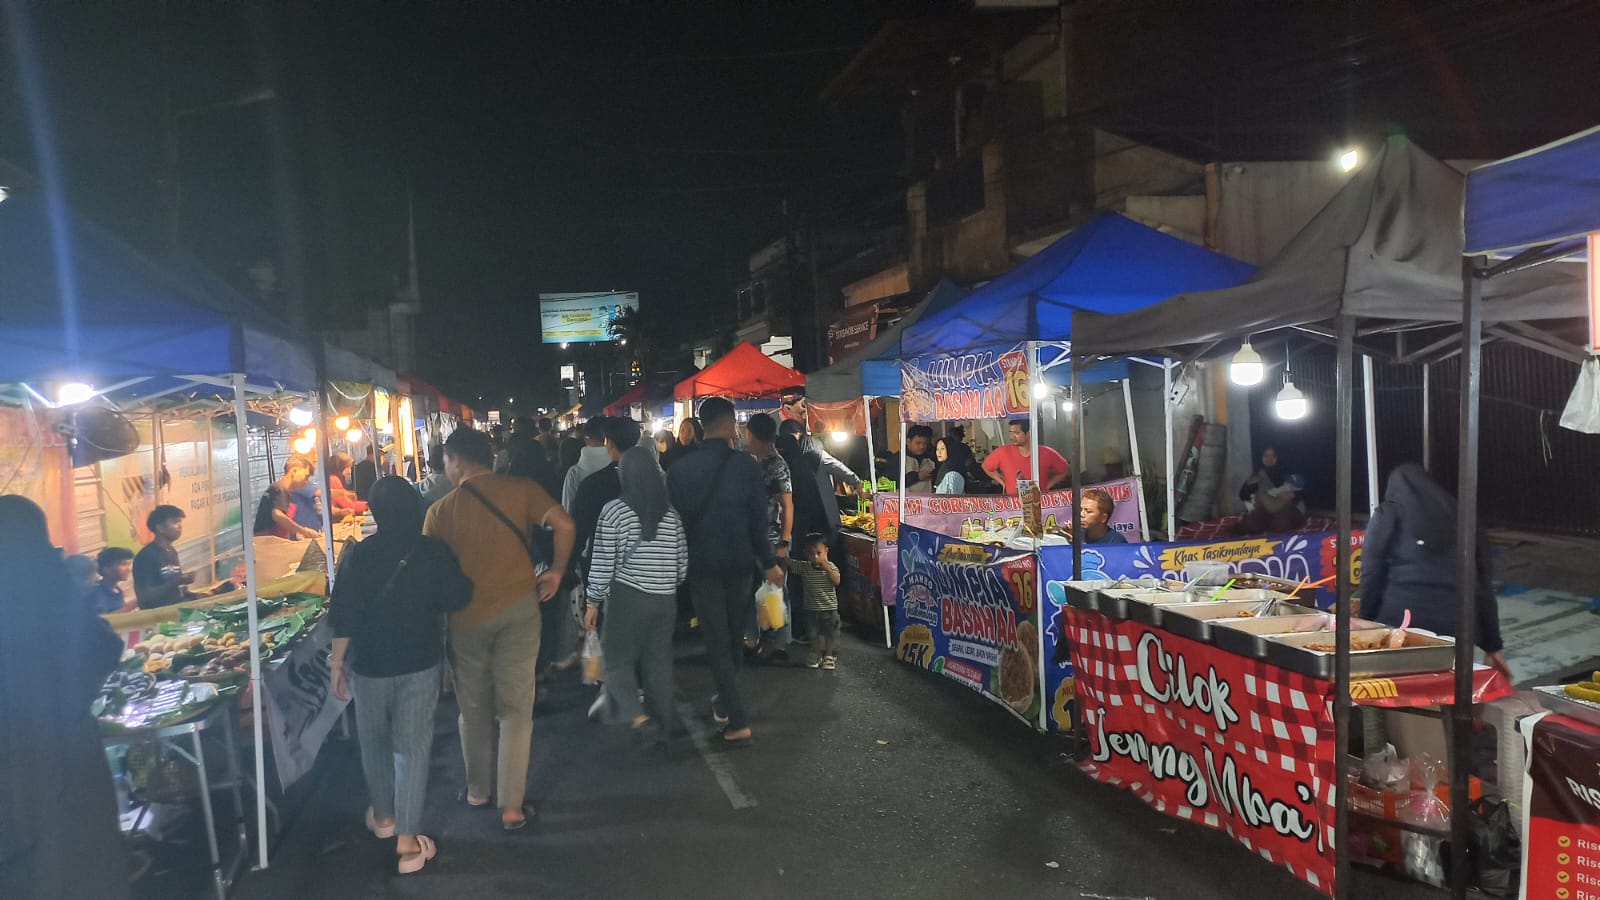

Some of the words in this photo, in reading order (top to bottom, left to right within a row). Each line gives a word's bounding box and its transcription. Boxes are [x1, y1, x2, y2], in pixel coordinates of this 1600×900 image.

[927, 351, 1000, 390] LUMPIA
[1006, 370, 1031, 408] 16
[983, 386, 1007, 418] AA
[928, 496, 991, 516] GORENG
[1173, 549, 1198, 566] Khas
[1202, 543, 1261, 564] Tasikmalaya
[931, 559, 1011, 608] LUMPIA
[1011, 571, 1033, 609] 16
[940, 596, 996, 644] BASAH
[995, 606, 1019, 652] AA
[902, 642, 930, 666] 15K
[1136, 632, 1239, 731] Cilok
